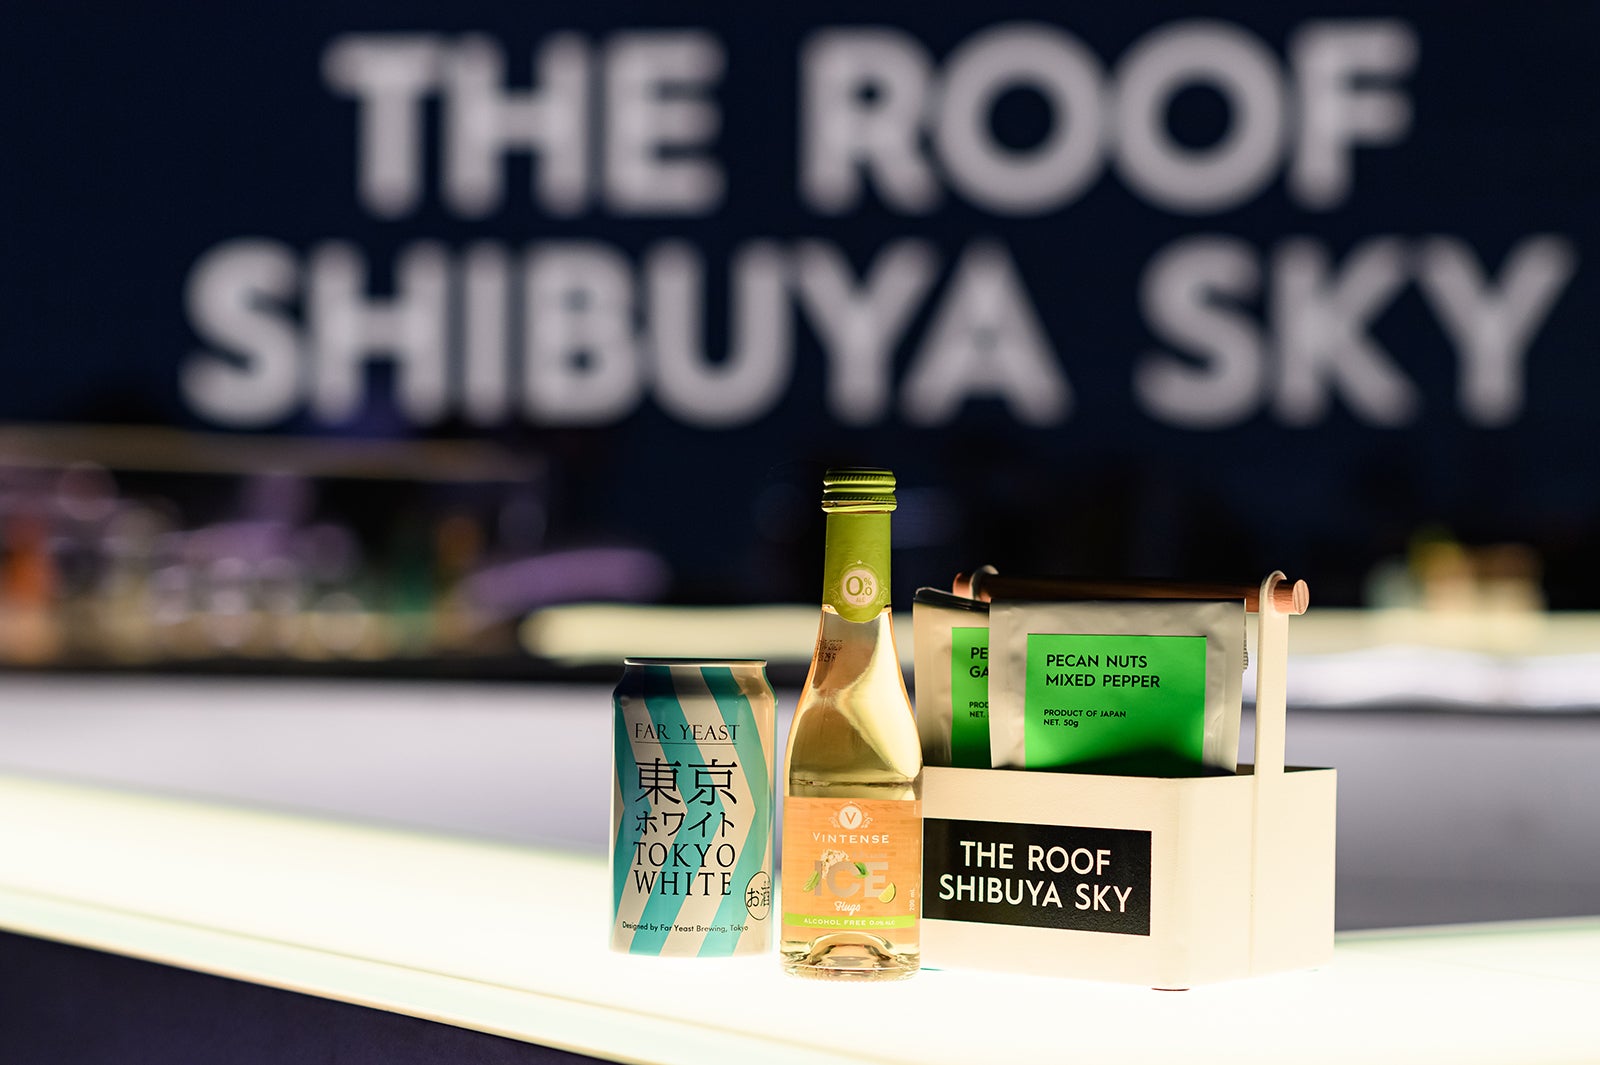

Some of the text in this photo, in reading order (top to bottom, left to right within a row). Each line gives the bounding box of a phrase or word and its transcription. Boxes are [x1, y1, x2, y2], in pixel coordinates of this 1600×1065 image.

[324, 20, 1416, 217] THE ROOF
[181, 235, 1575, 428] SHIBUYA SKY
[1046, 654, 1148, 668] PECAN NUTS
[1046, 674, 1160, 688] MIXED PEPPER
[1043, 709, 1083, 717] PRODUCT
[1100, 710, 1126, 718] JAPAN
[635, 722, 740, 741] FAR YEAST
[1063, 719, 1079, 728] 50g
[635, 757, 738, 805] 東京
[635, 811, 735, 837] ホワイト
[845, 812, 857, 825] V
[812, 832, 889, 844] VINTENSE
[633, 842, 735, 868] TOKYO
[960, 841, 1111, 876] THE ROOF
[633, 870, 732, 896] WHITE
[814, 861, 888, 898] ICE
[939, 873, 1133, 913] SHIBUYA SKY
[834, 901, 861, 916] Hugo
[622, 920, 748, 933] Designed by Far Yeast Brewing, Tokyo
[804, 918, 841, 926] ALCOHOL
